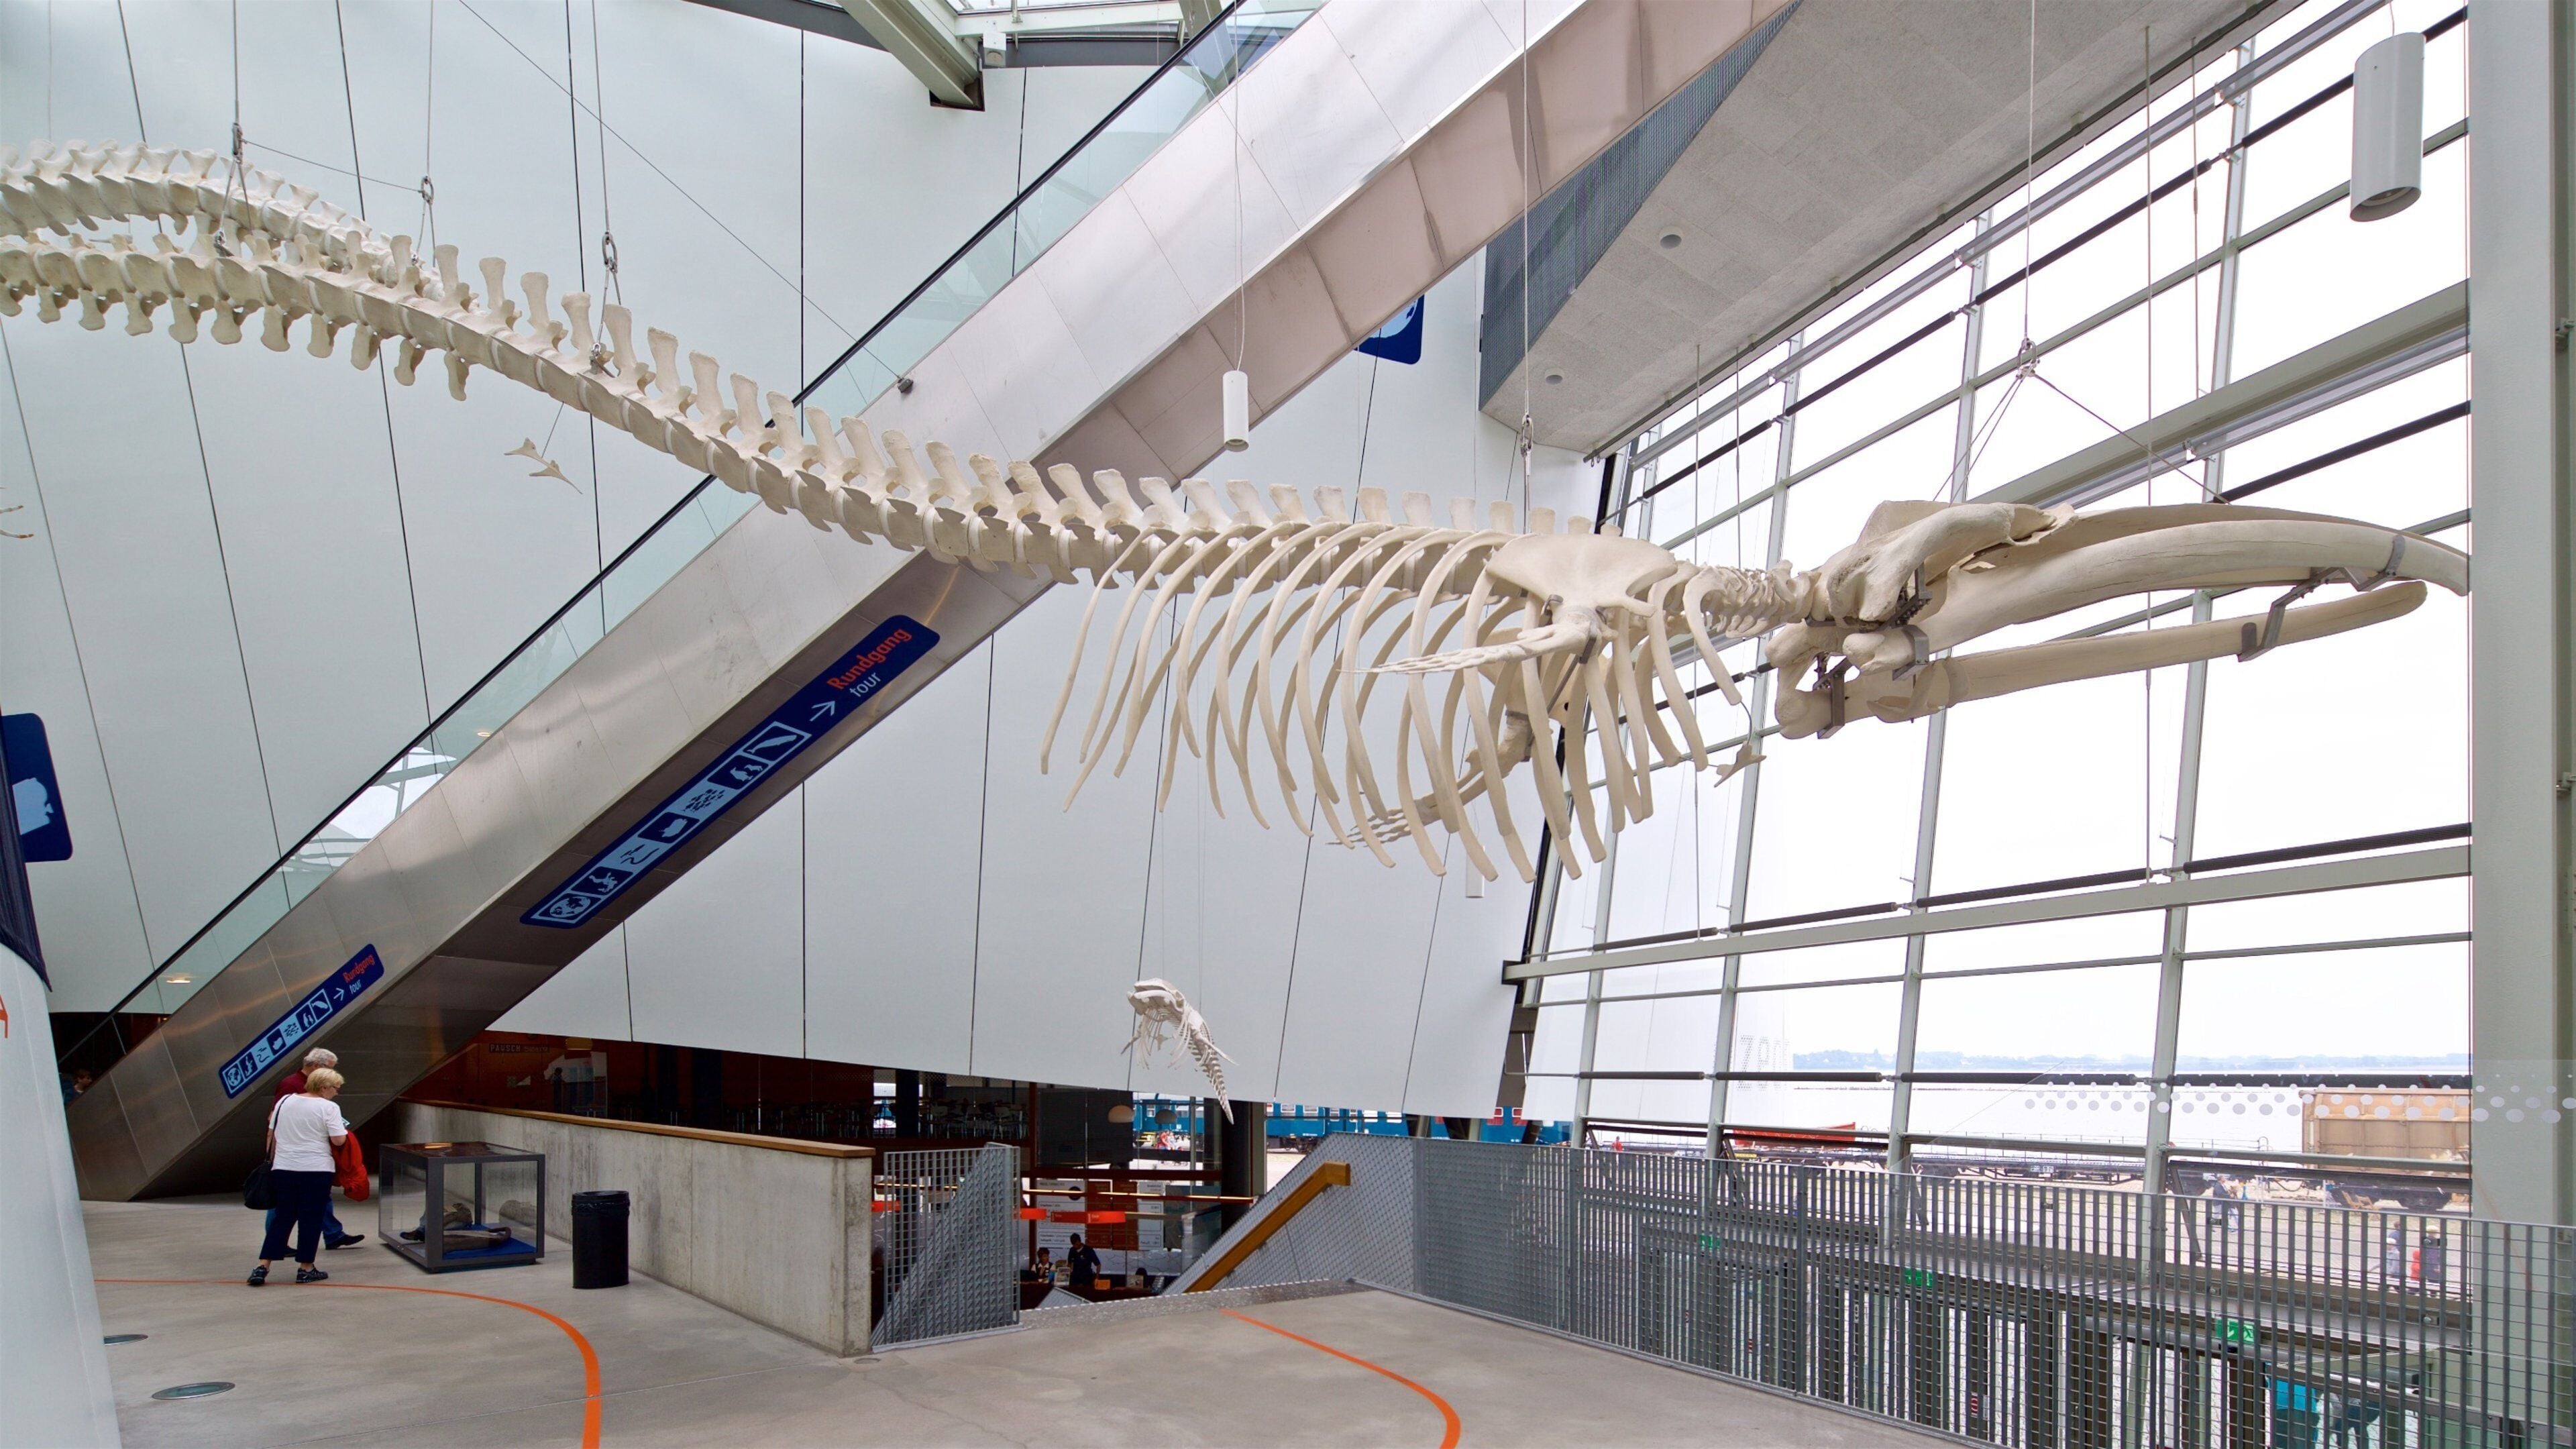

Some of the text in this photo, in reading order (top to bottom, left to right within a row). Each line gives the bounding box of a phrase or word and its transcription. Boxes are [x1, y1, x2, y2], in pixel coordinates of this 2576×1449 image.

[827, 629, 912, 690] Rundgang
[849, 672, 881, 698] tour
[343, 954, 376, 983] Rundgang
[349, 979, 362, 994] tour
